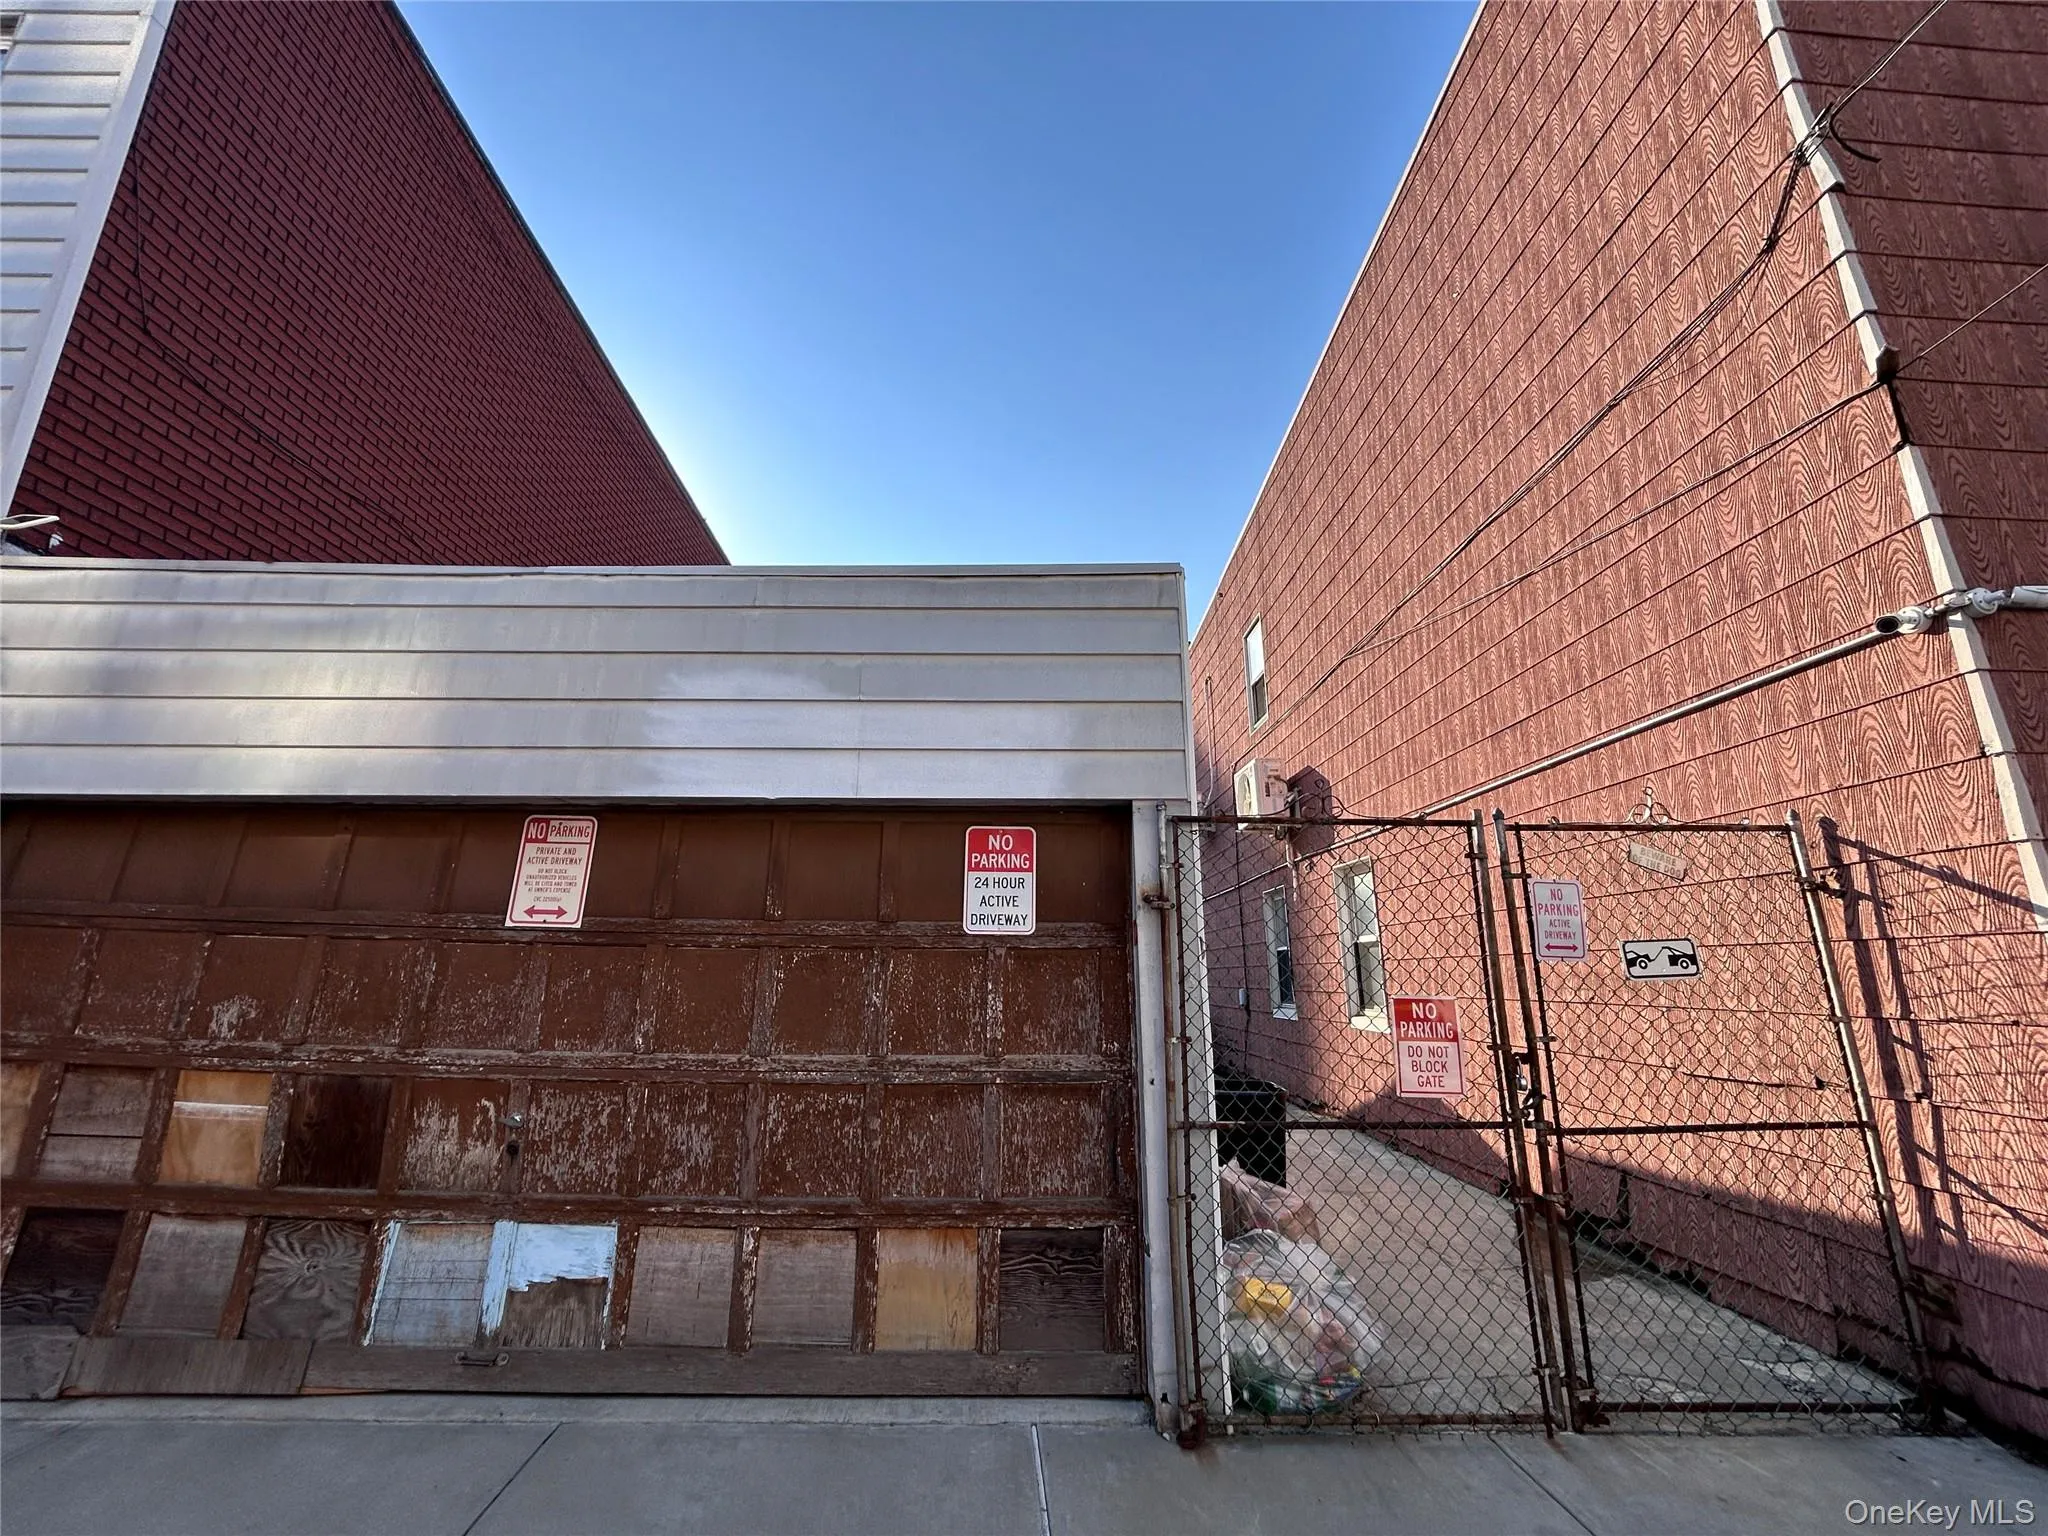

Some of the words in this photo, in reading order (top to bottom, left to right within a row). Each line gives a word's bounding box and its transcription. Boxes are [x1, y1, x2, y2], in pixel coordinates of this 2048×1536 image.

[527, 822, 546, 839] NO
[549, 825, 590, 838] PARKING
[988, 834, 1013, 851] NO
[536, 846, 562, 855] PRIVATE
[562, 847, 577, 855] AND
[1640, 847, 1677, 866] BEWARE
[526, 857, 548, 865] ACTIVE
[550, 857, 582, 865] DRIVEWAY
[971, 853, 1030, 869] PARKING
[1632, 854, 1641, 864] OF
[1645, 858, 1662, 871] THE
[1663, 866, 1681, 878] DOG
[974, 876, 989, 889] 24
[993, 876, 1025, 889] HOUR
[980, 895, 1019, 907] ACTIVE
[1550, 888, 1563, 901] NO
[1538, 903, 1579, 917] PARKING
[971, 914, 1028, 926] DRIVEWAY
[1548, 918, 1571, 928] ACTIVE
[1544, 930, 1577, 940] DRIVEWAY
[1411, 1002, 1437, 1019] NO
[1400, 1021, 1454, 1039] PARKING
[1407, 1045, 1423, 1058] DO
[1428, 1045, 1449, 1058] NOT
[1411, 1060, 1448, 1073] BLOCK
[1417, 1074, 1445, 1088] GATE
